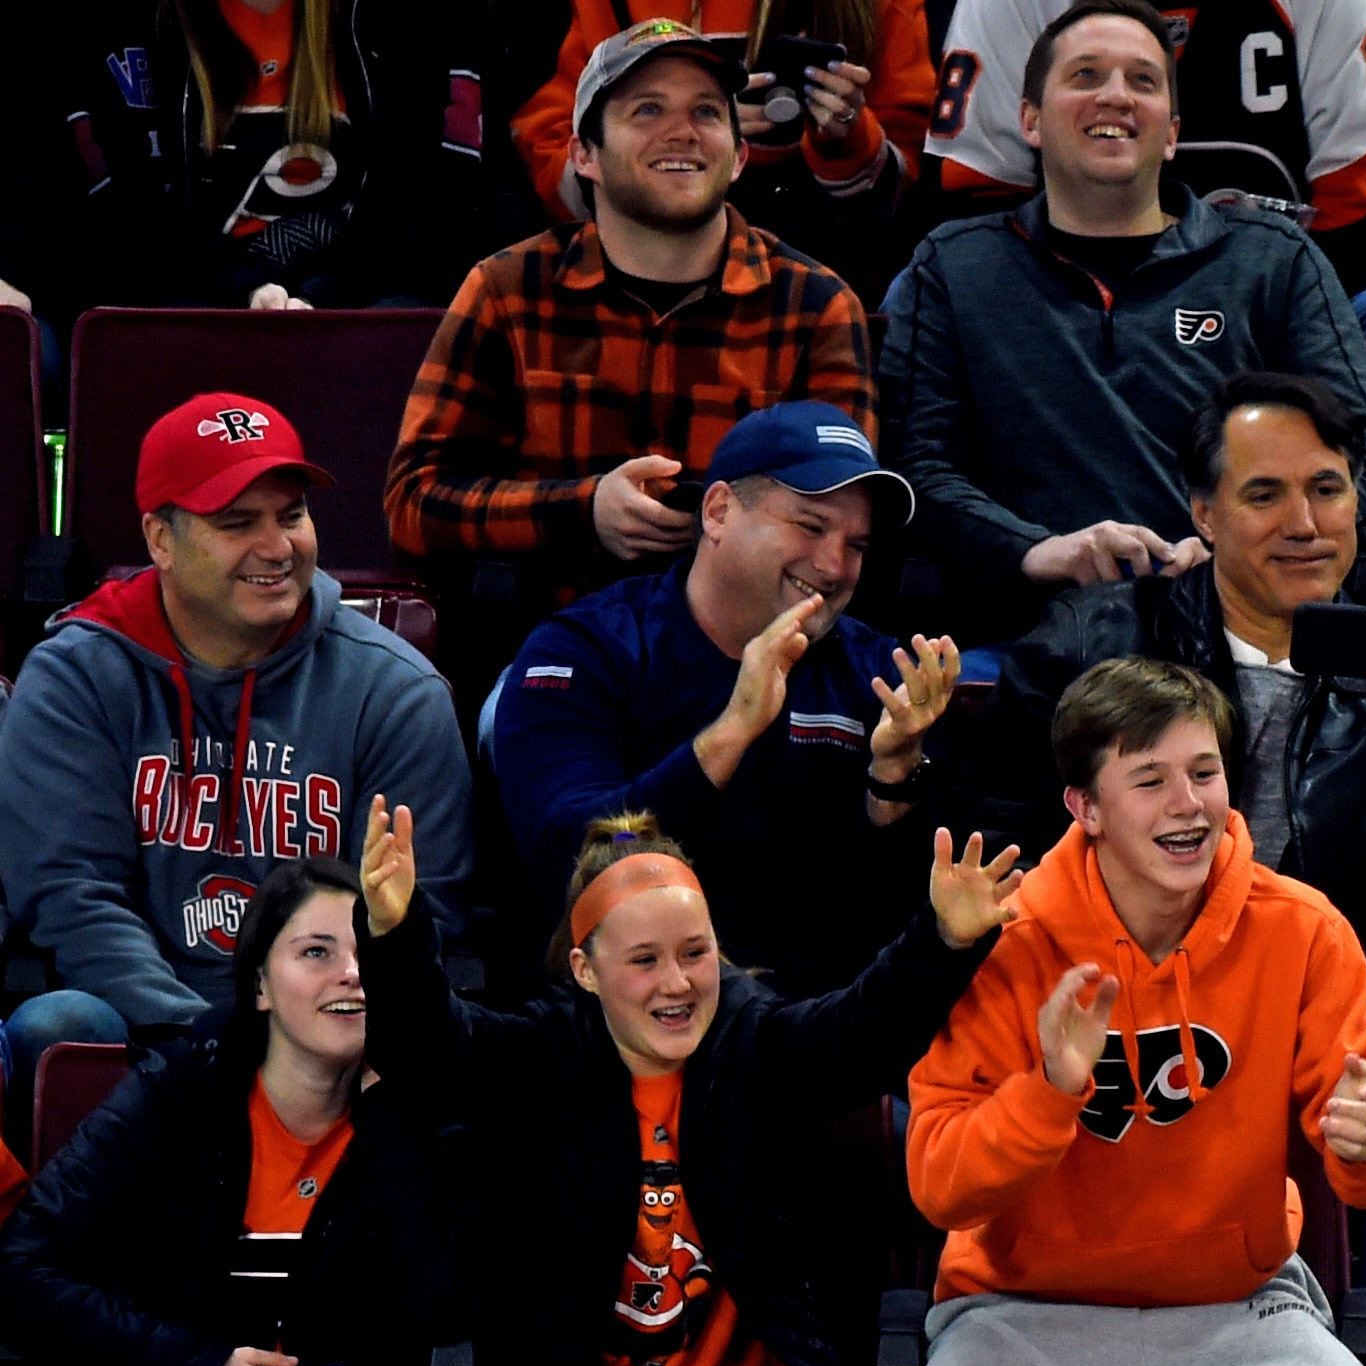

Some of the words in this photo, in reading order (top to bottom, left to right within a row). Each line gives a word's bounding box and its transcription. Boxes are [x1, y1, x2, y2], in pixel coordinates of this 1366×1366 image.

[1241, 31, 1287, 114] C
[216, 408, 264, 445] R
[133, 754, 341, 860] BUCYES
